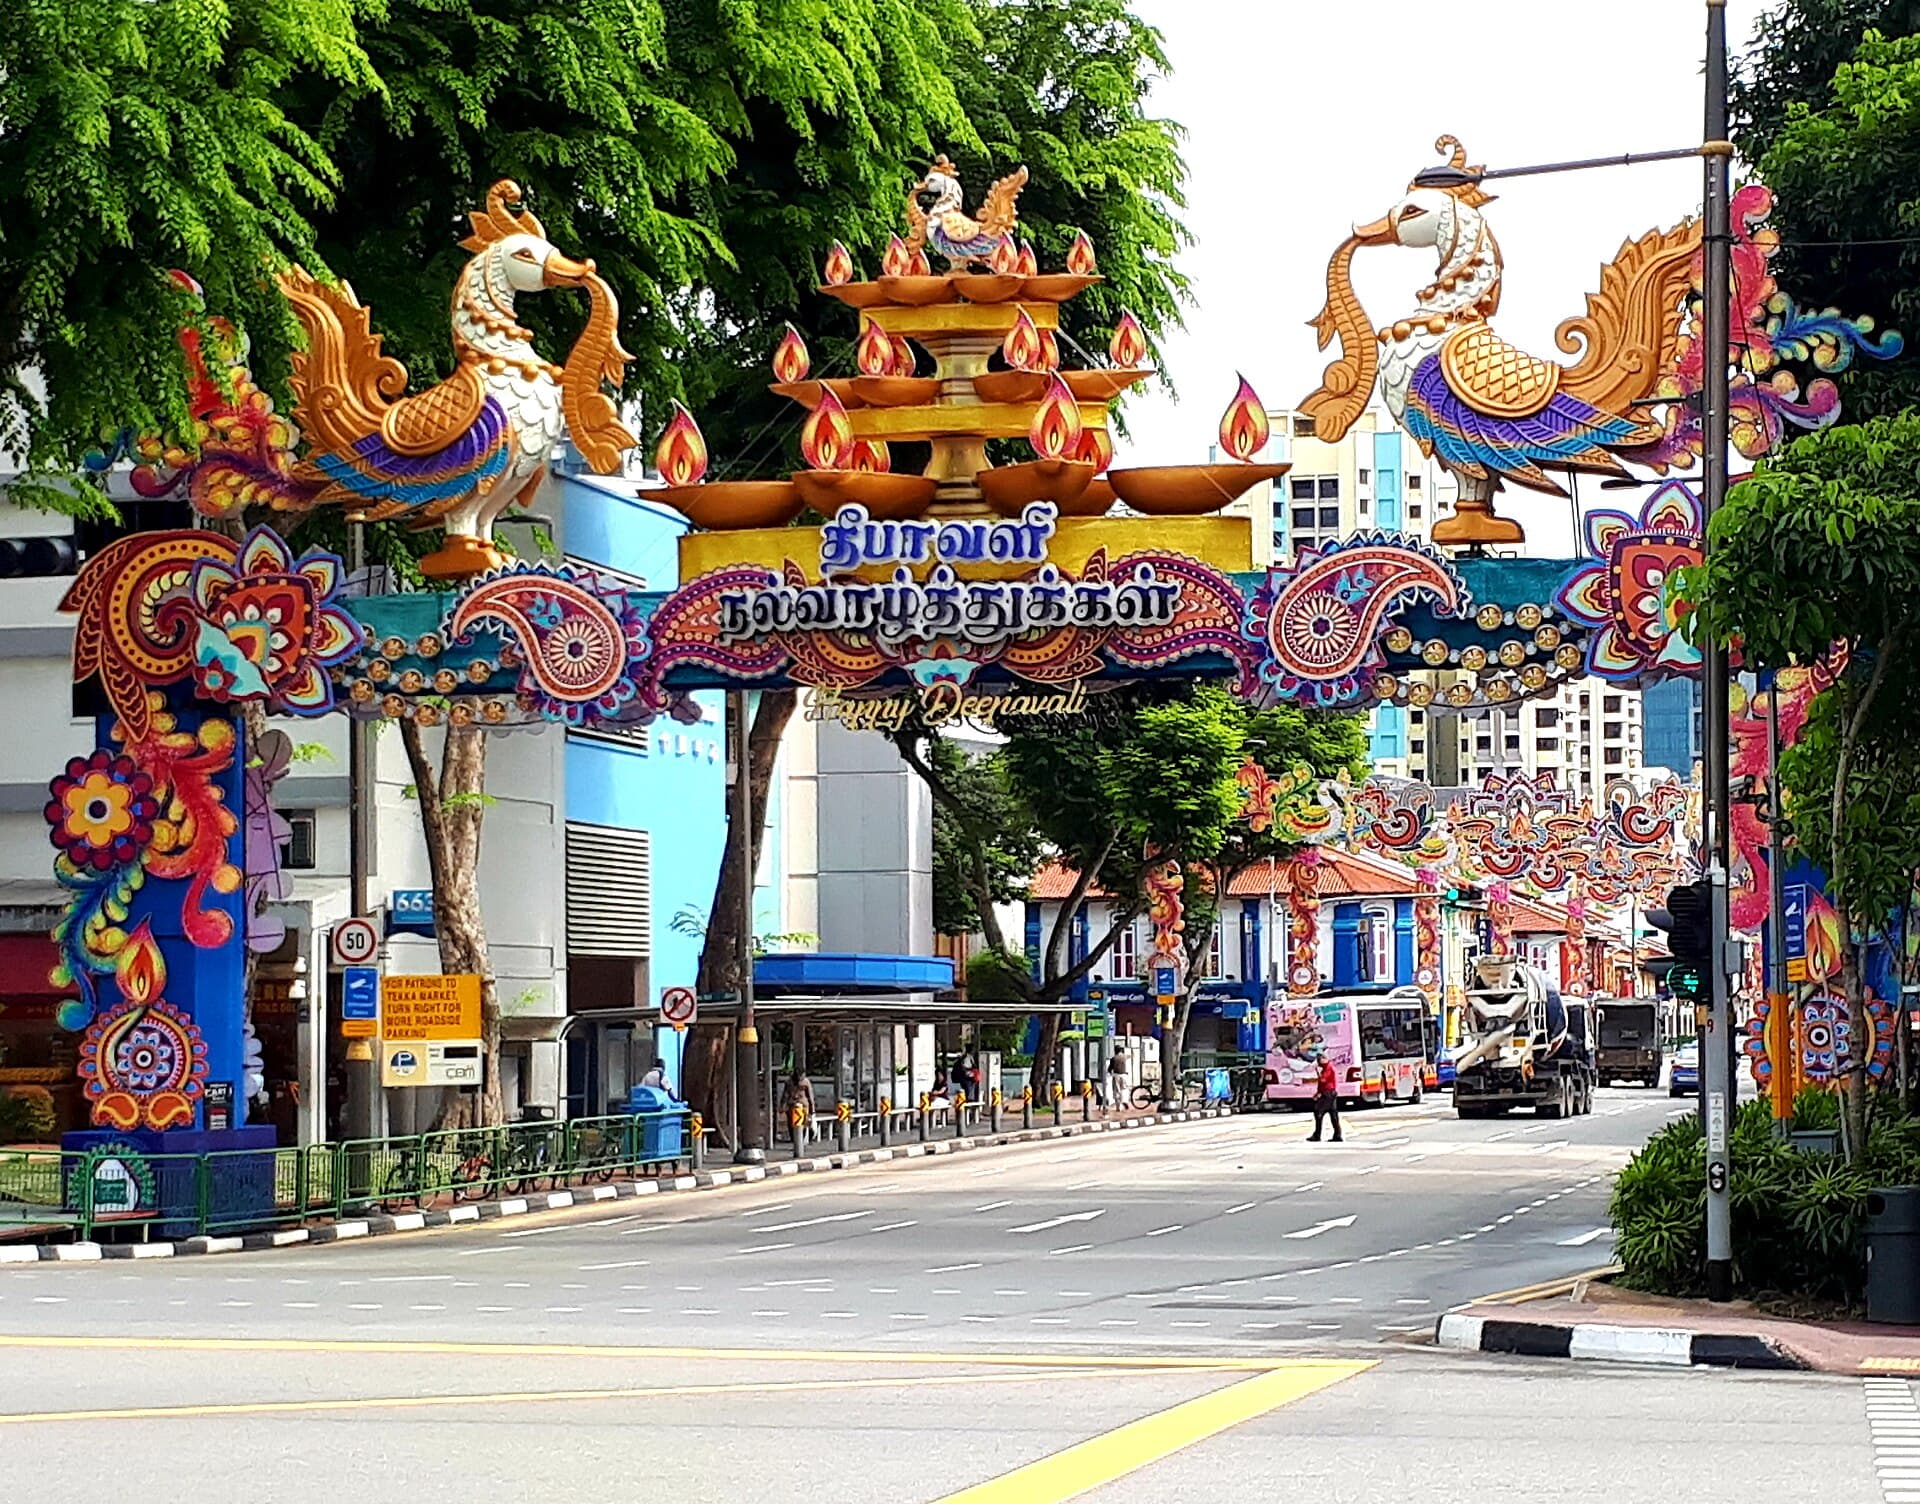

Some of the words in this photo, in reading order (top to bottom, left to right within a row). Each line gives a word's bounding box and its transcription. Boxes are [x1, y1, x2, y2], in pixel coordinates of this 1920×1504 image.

[820, 503, 1057, 574] தீபாவளி
[717, 564, 1180, 642] நல்வாழ்த்துக்கள்
[803, 684, 916, 731] Happy
[920, 679, 1087, 730] Deepavali
[346, 932, 365, 950] 50
[446, 978, 457, 988] TO
[387, 1004, 412, 1014] TURN
[414, 1003, 441, 1013] RIGHT
[443, 1002, 461, 1013] FOR
[386, 1016, 412, 1026] MORE
[416, 1015, 461, 1025] ROADSIDE
[1706, 1019, 1714, 1033] 9
[386, 1028, 427, 1038] PARKING
